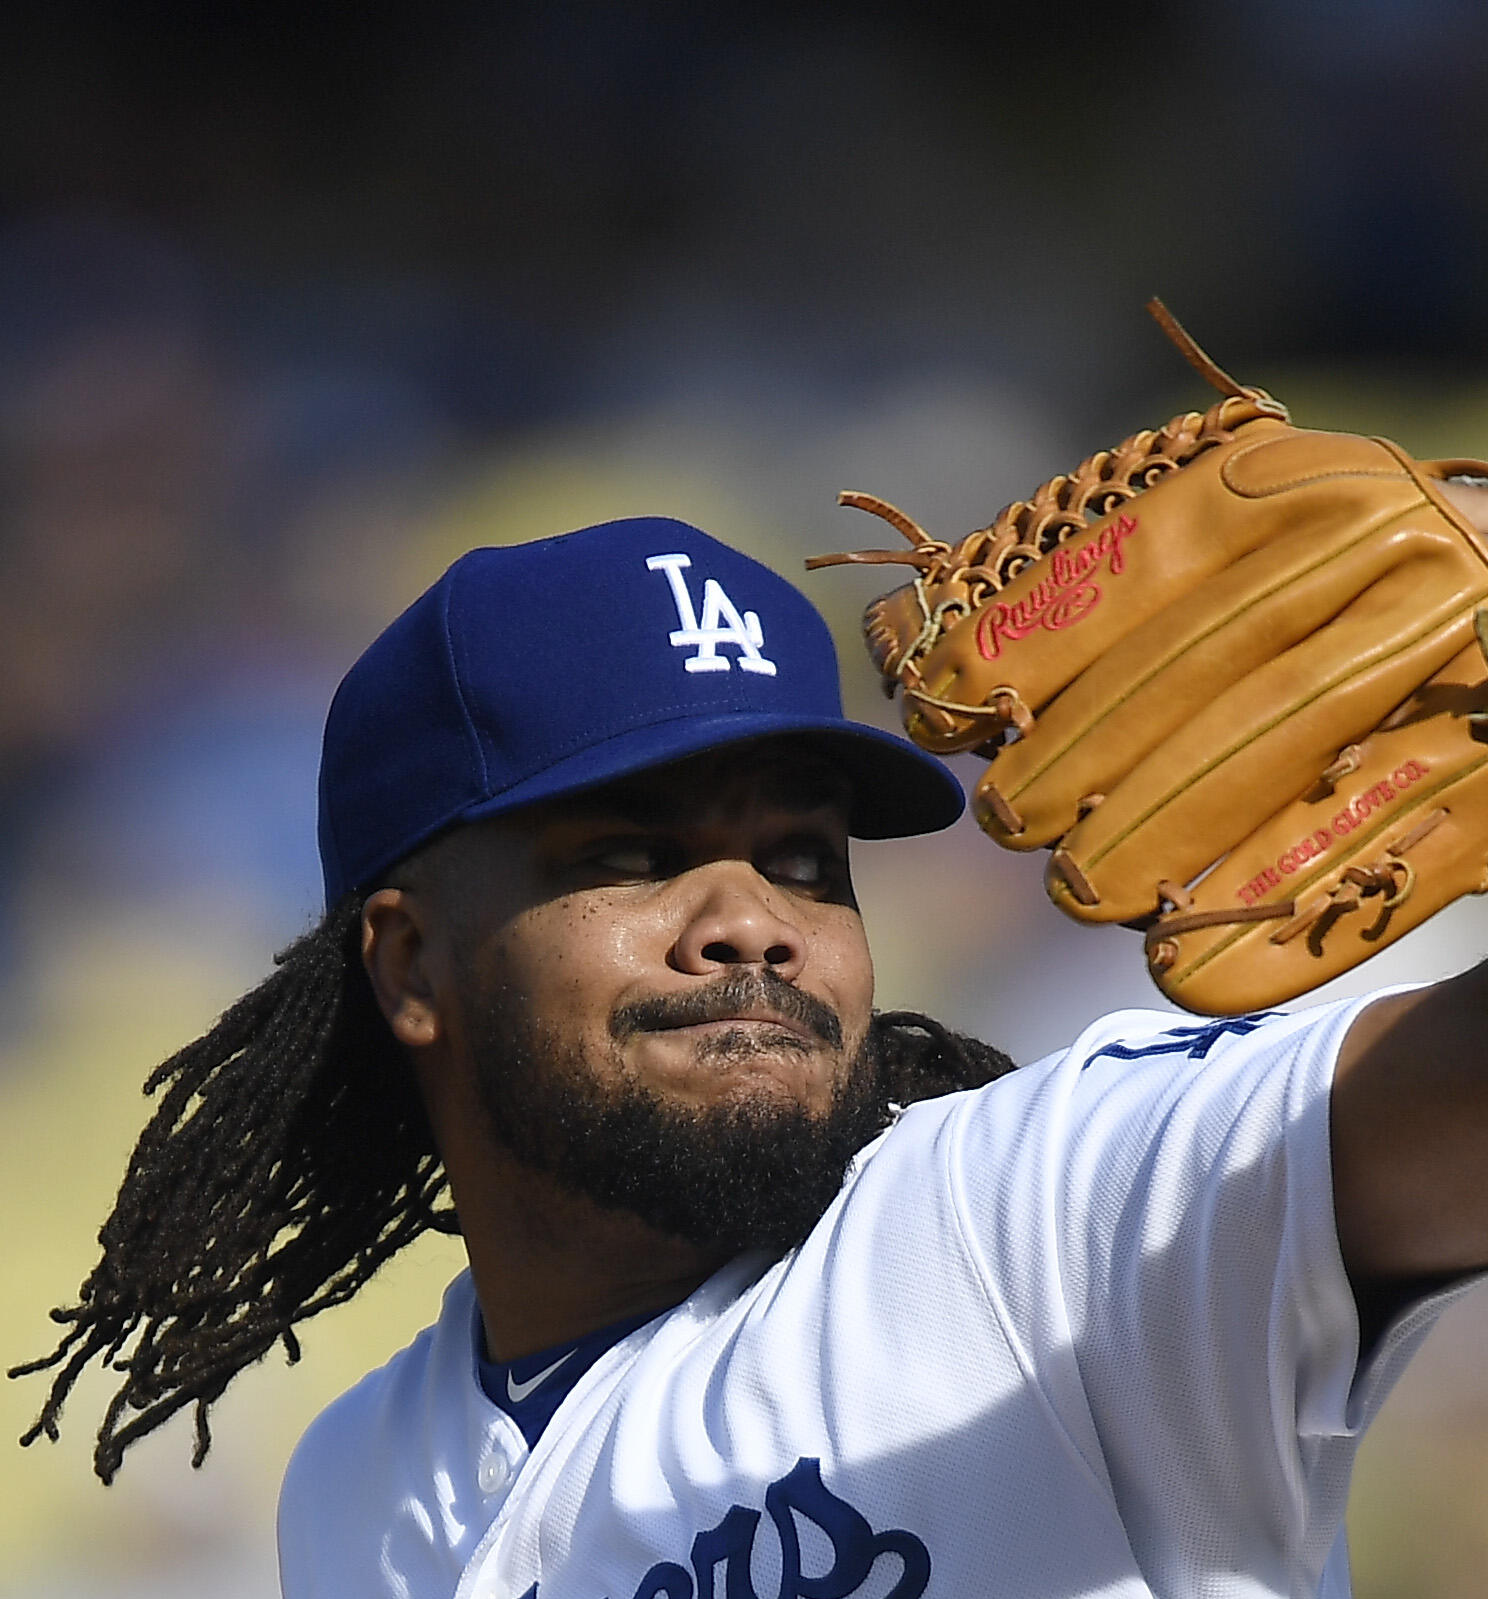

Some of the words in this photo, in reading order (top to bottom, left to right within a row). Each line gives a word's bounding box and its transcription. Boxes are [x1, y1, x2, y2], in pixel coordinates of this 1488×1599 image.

[645, 553, 777, 677] LA
[976, 513, 1139, 661] Rawlings
[1237, 866, 1281, 906] THE
[1277, 828, 1333, 875] GOLD
[1332, 779, 1397, 836] GLOVE
